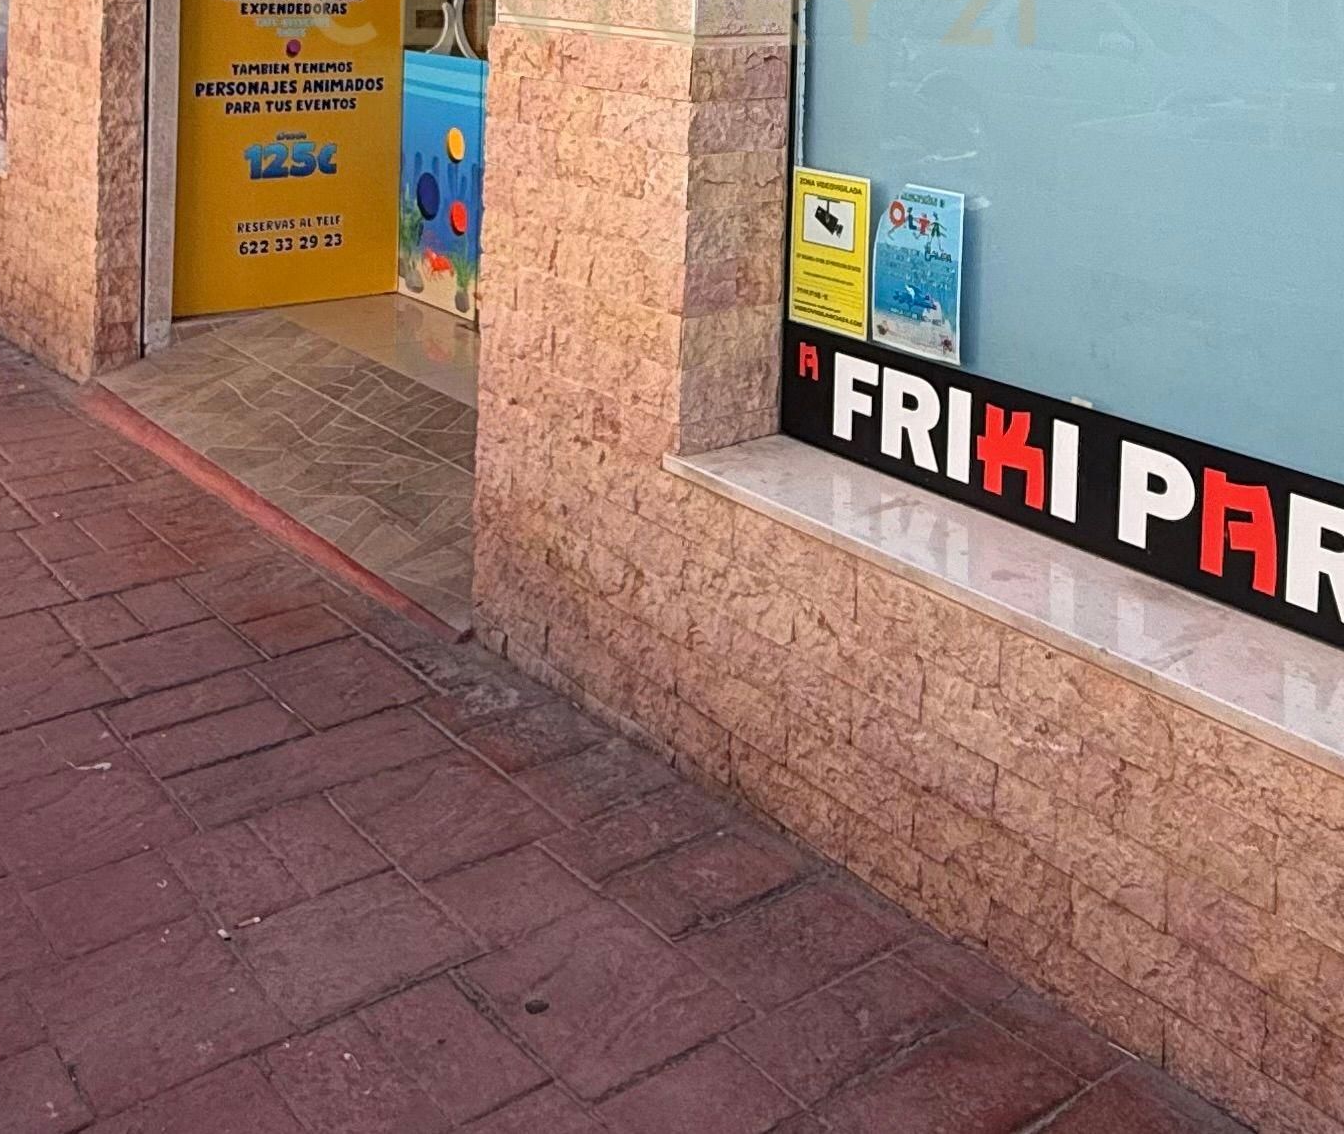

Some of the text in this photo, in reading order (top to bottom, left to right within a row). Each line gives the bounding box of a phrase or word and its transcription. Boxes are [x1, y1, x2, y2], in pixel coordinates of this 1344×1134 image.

[240, 2, 347, 15] EXPENDEDORAS
[232, 61, 353, 76] TAMBIEN TENEMOS
[195, 77, 384, 97] PERSONAJES ANIMADOS
[225, 98, 357, 114] PARA TUS EVENTOS
[237, 215, 341, 233] RESERVAS AL TELF
[239, 233, 343, 255] 622 33 29 23
[833, 351, 1080, 525] FRIKI
